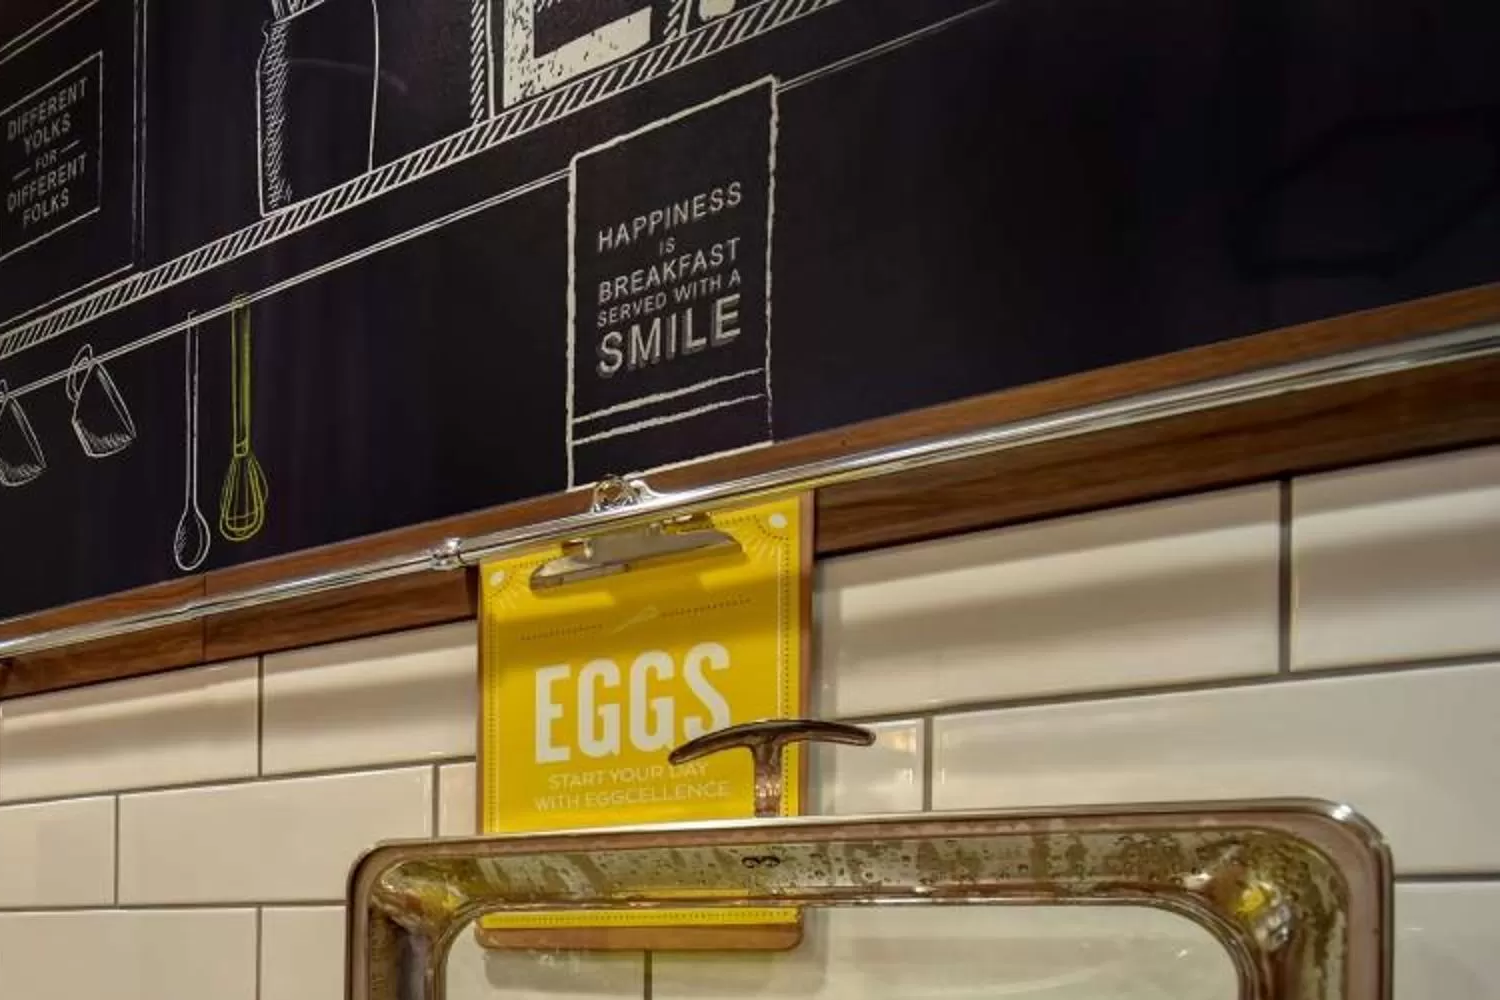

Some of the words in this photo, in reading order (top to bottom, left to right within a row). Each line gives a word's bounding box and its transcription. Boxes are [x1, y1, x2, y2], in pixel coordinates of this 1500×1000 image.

[7, 76, 88, 141] DIFFERENT
[23, 112, 71, 155] YOLKS
[7, 151, 87, 213] DIFFERENT
[35, 149, 58, 173] FOR
[22, 187, 70, 229] FOLKS
[598, 181, 742, 252] HAPPINESS
[598, 237, 741, 304] BREAKFAST
[658, 237, 676, 256] IS
[597, 291, 668, 328] SERVED
[674, 274, 722, 303] WITH
[727, 268, 741, 289] A
[596, 292, 741, 379] SMILE
[535, 641, 731, 766] EGGS
[535, 794, 580, 811] WITH
[585, 780, 731, 808] EGGCELLENCE
[548, 771, 607, 790] START
[611, 766, 663, 784] YOUR
[669, 761, 709, 777] DAY
